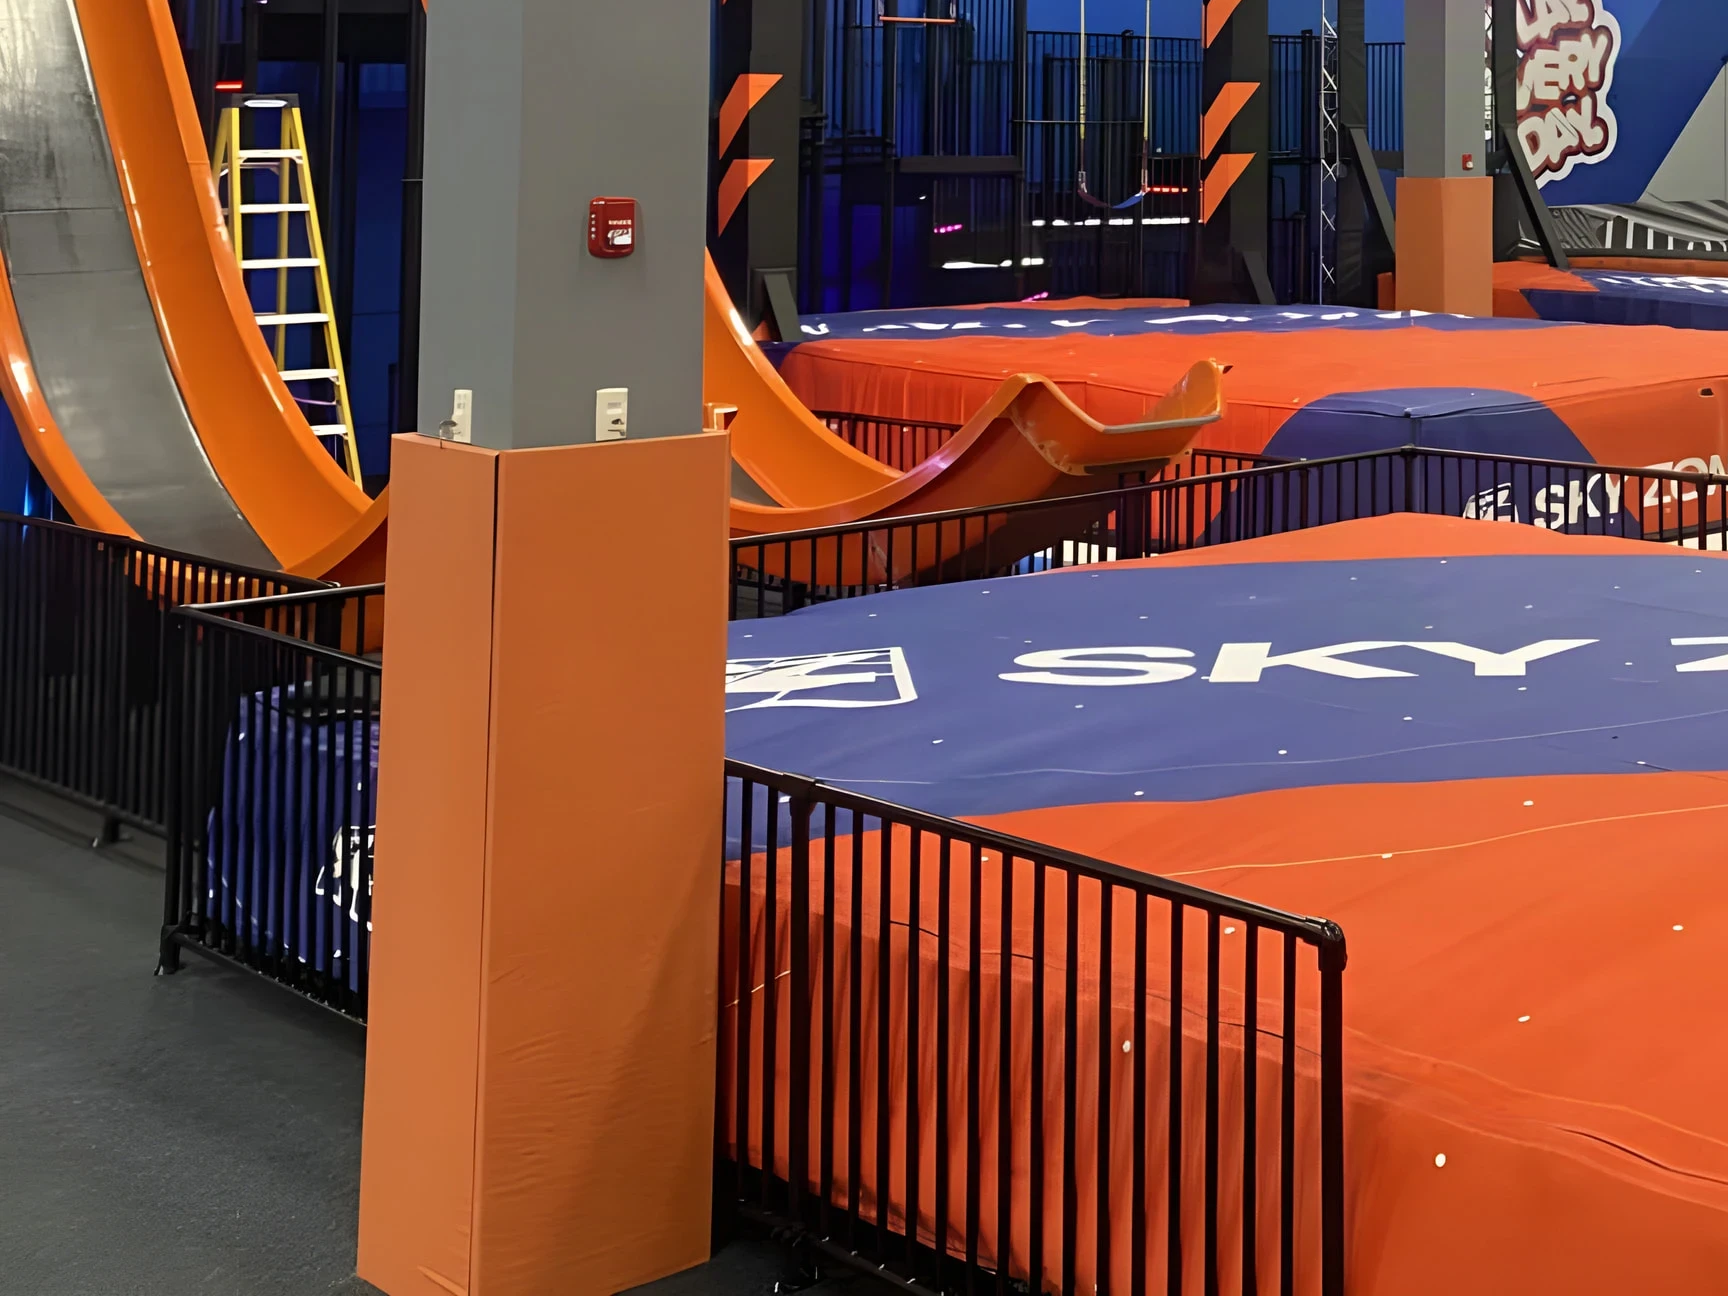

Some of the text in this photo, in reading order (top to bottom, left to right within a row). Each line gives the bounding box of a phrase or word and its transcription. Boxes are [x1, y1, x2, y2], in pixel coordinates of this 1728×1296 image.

[1517, 95, 1605, 174] DAY
[1533, 470, 1629, 530] SKY
[998, 638, 1600, 687] SKY
